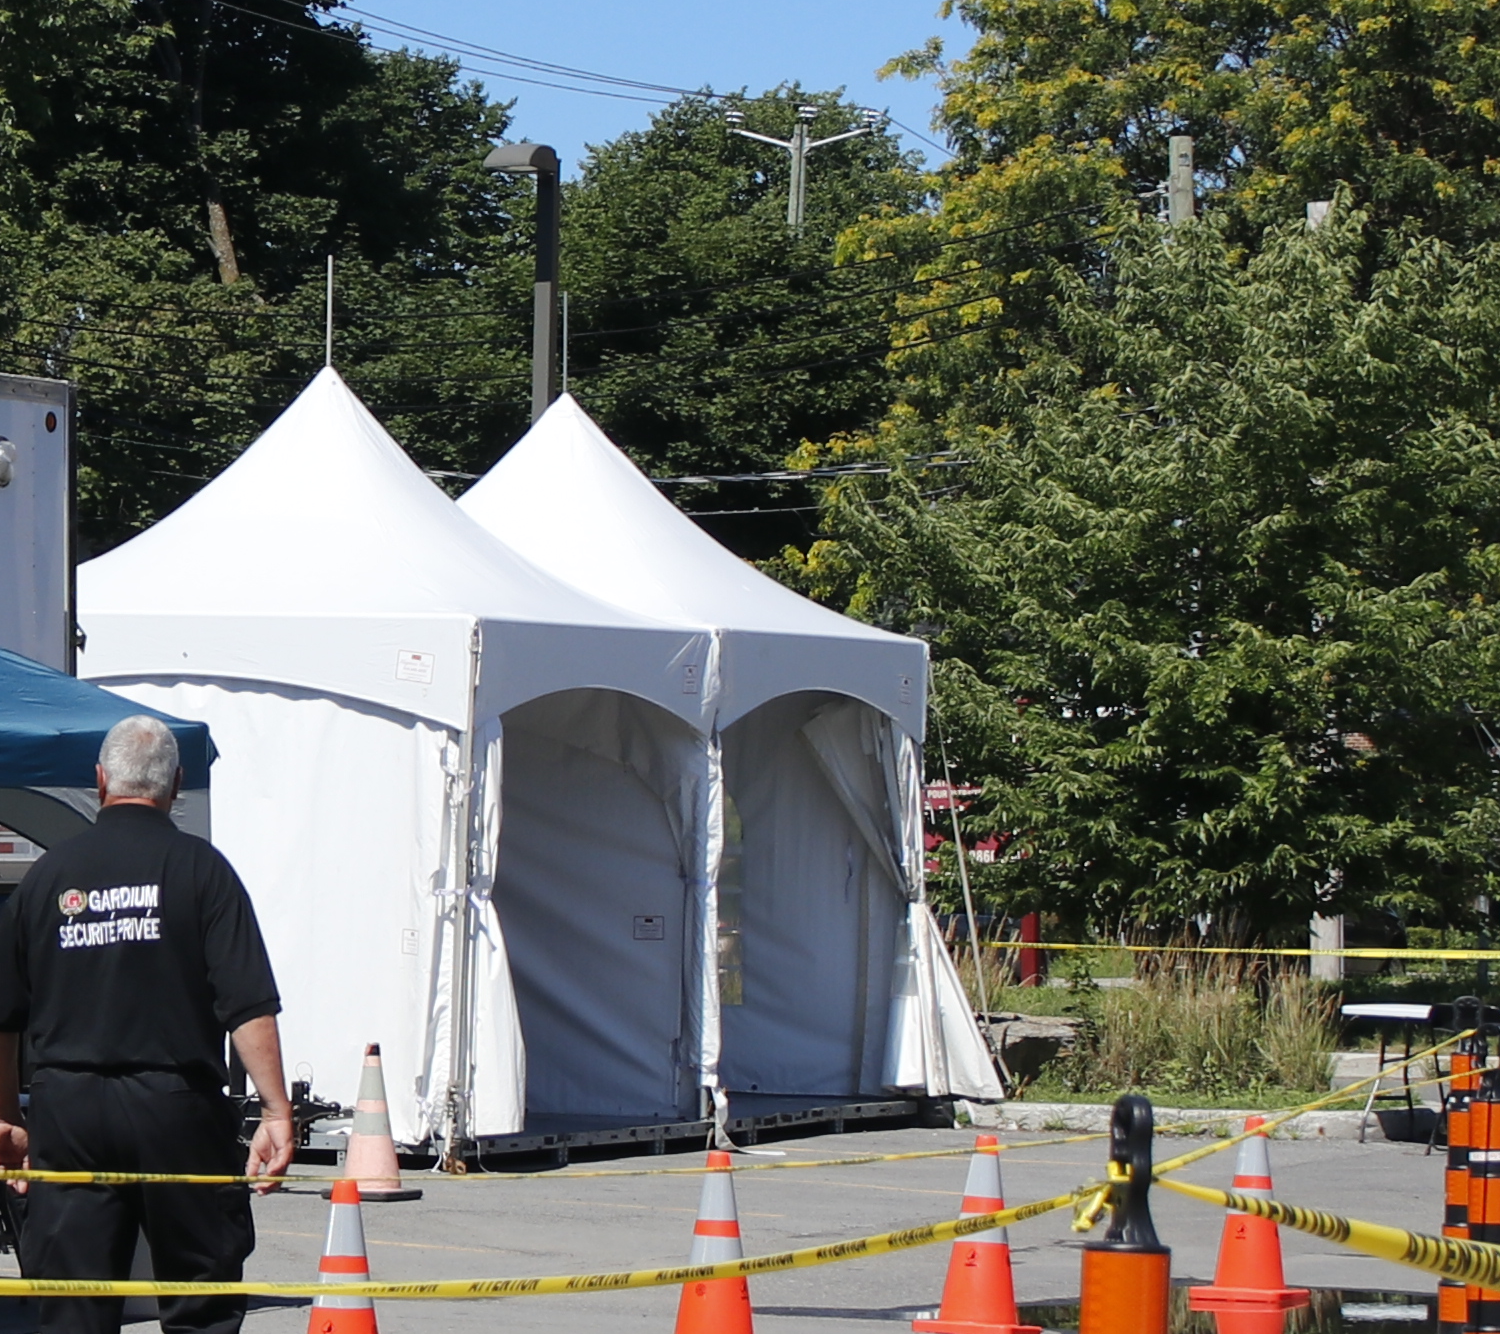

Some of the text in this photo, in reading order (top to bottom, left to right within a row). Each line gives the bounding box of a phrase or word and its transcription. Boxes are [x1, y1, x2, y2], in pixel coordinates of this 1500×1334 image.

[89, 884, 159, 912] GARDIUM
[59, 908, 160, 948] SÉCURITÉ PRIVÉE
